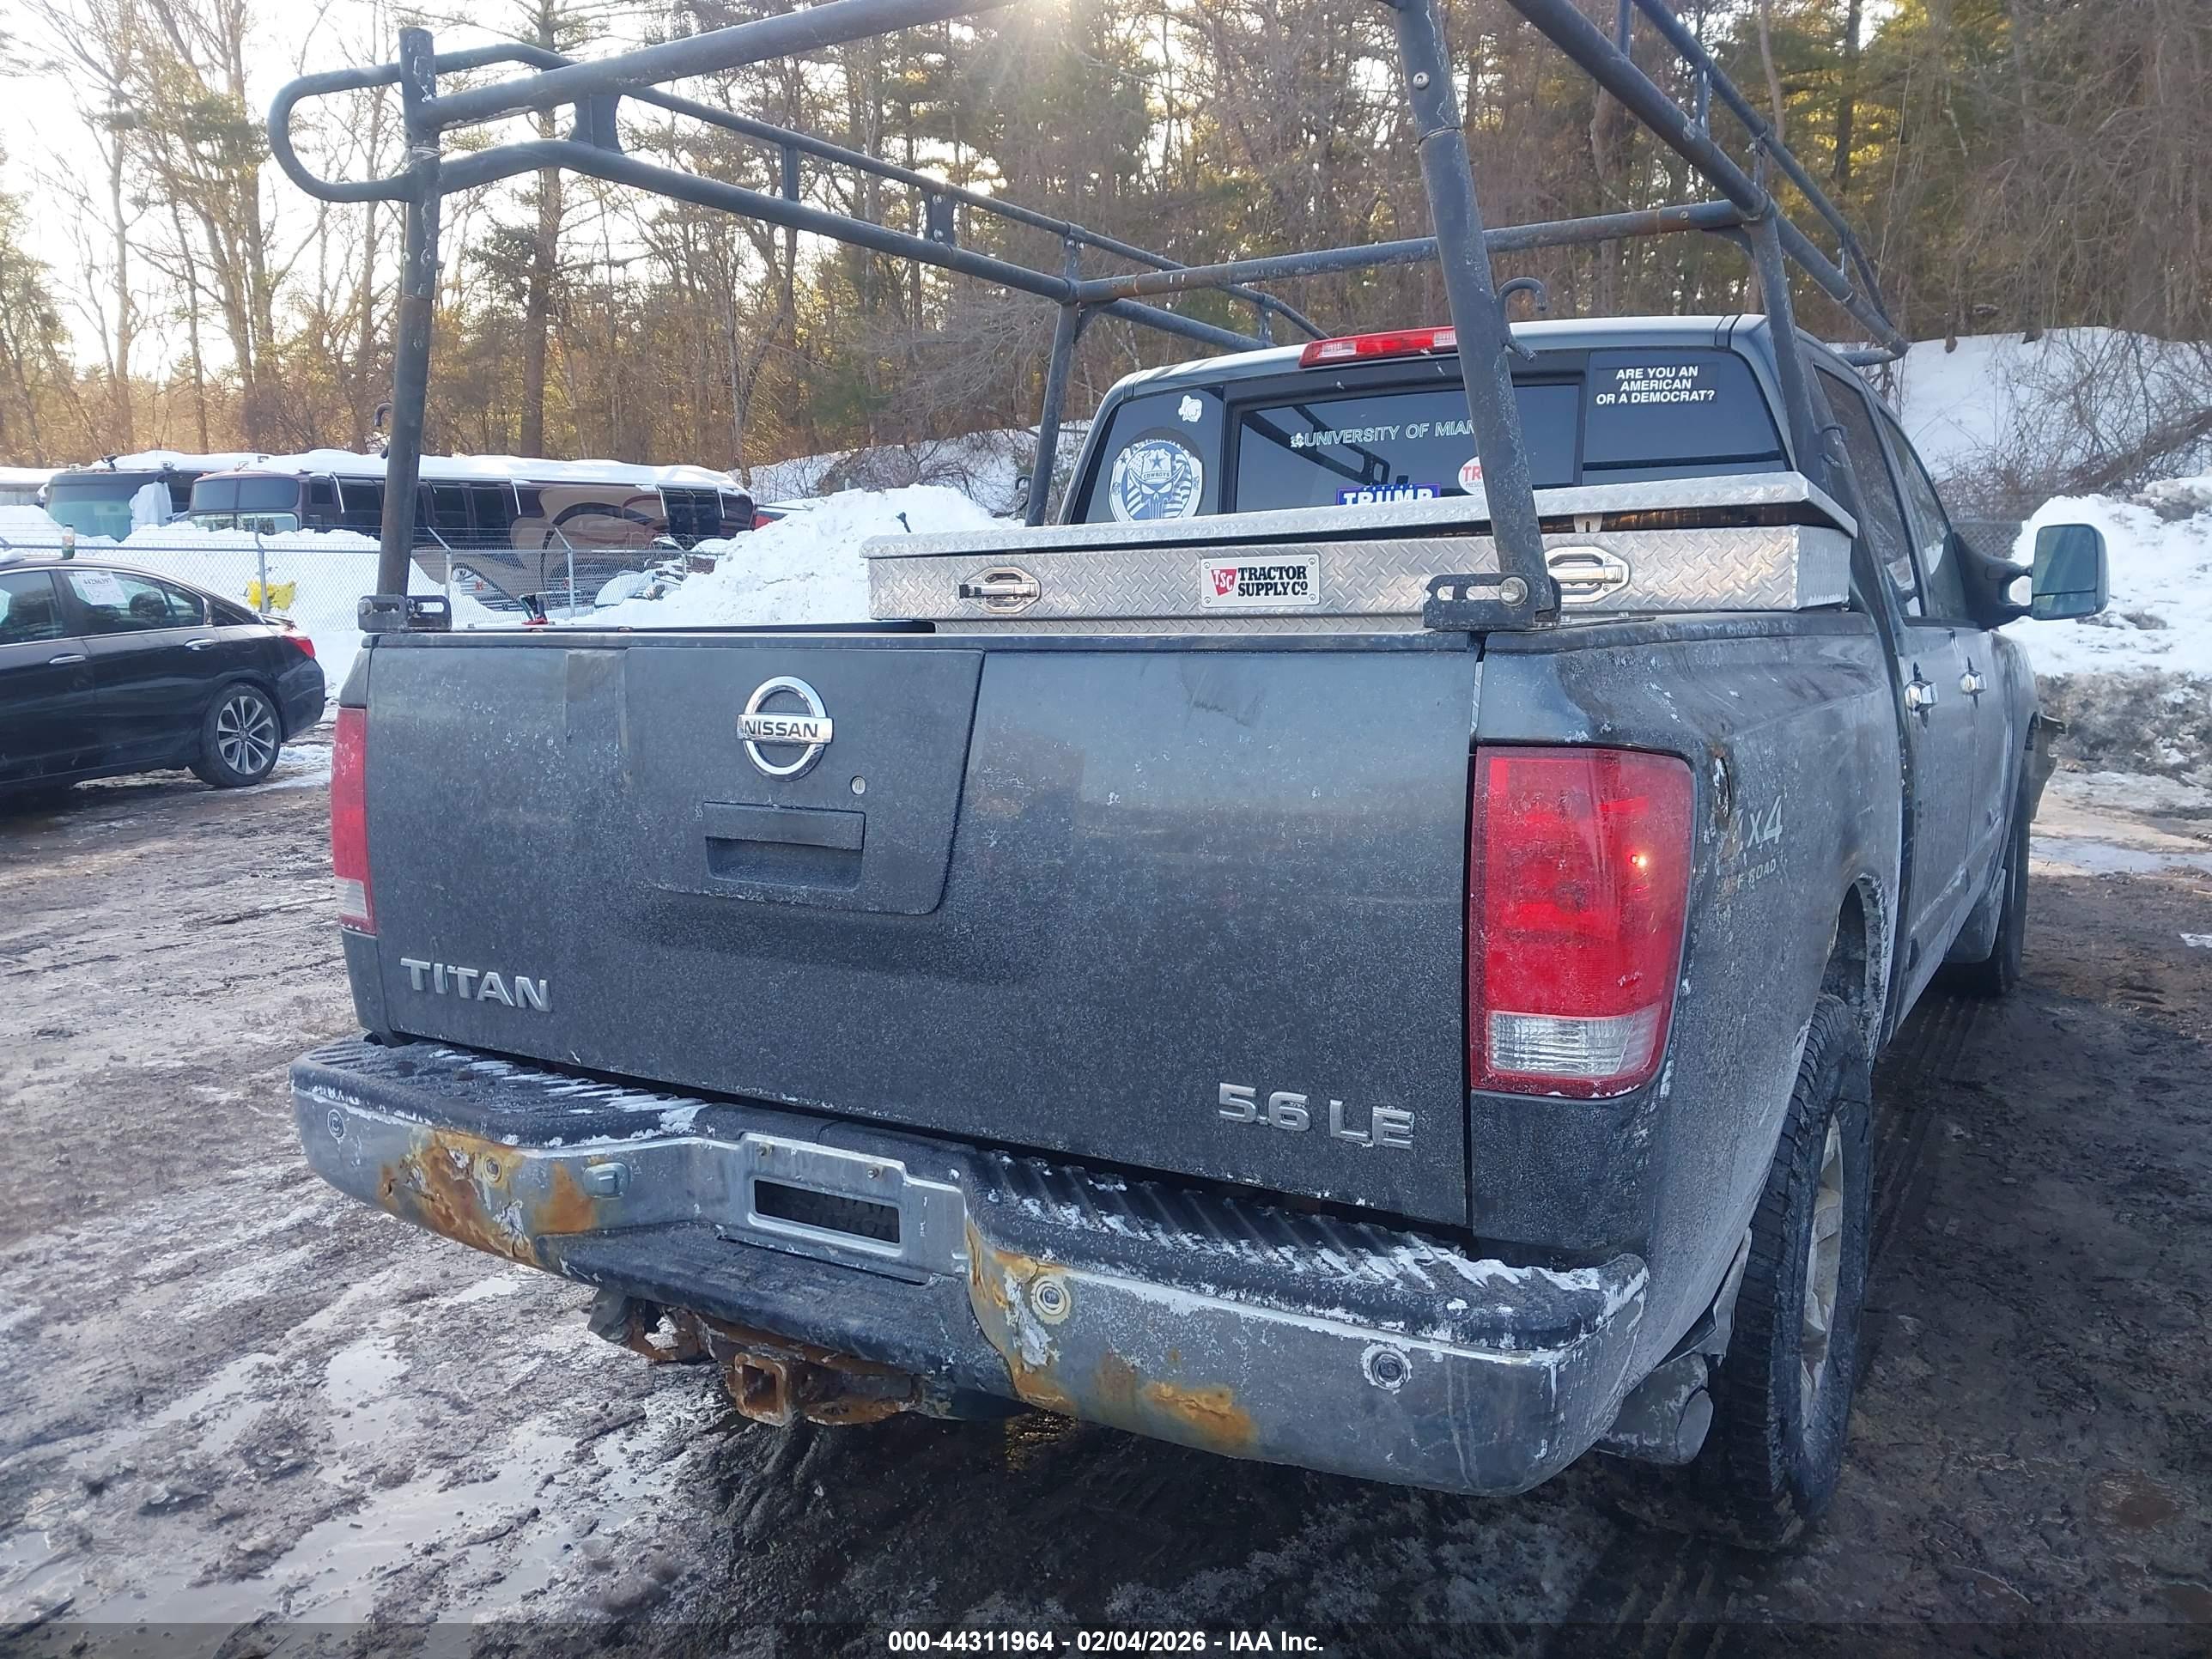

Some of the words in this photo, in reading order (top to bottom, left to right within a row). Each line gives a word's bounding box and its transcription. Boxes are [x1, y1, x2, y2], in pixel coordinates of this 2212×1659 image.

[1615, 368, 1644, 380] ARE
[1647, 367, 1676, 378] YOU
[1679, 365, 1698, 377] AN
[1620, 379, 1692, 392] AMERICAN
[1595, 393, 1616, 405] OR
[1618, 393, 1628, 404] A
[1631, 390, 1716, 404] DEMOCRAT?
[1304, 424, 1401, 447] UNIVERSITY
[1405, 422, 1430, 439] OF
[1434, 419, 1475, 437] MIAM
[1462, 465, 1481, 483] TR
[1343, 489, 1433, 505] TRUMP
[1212, 569, 1233, 591] TSC
[1237, 566, 1308, 581] TRACTOR
[1237, 581, 1291, 597] SUPPLY
[744, 720, 818, 738] NISSAN
[400, 957, 552, 1012] TITAN
[1218, 1082, 1311, 1132] 5.6
[1329, 1099, 1415, 1150] LE
